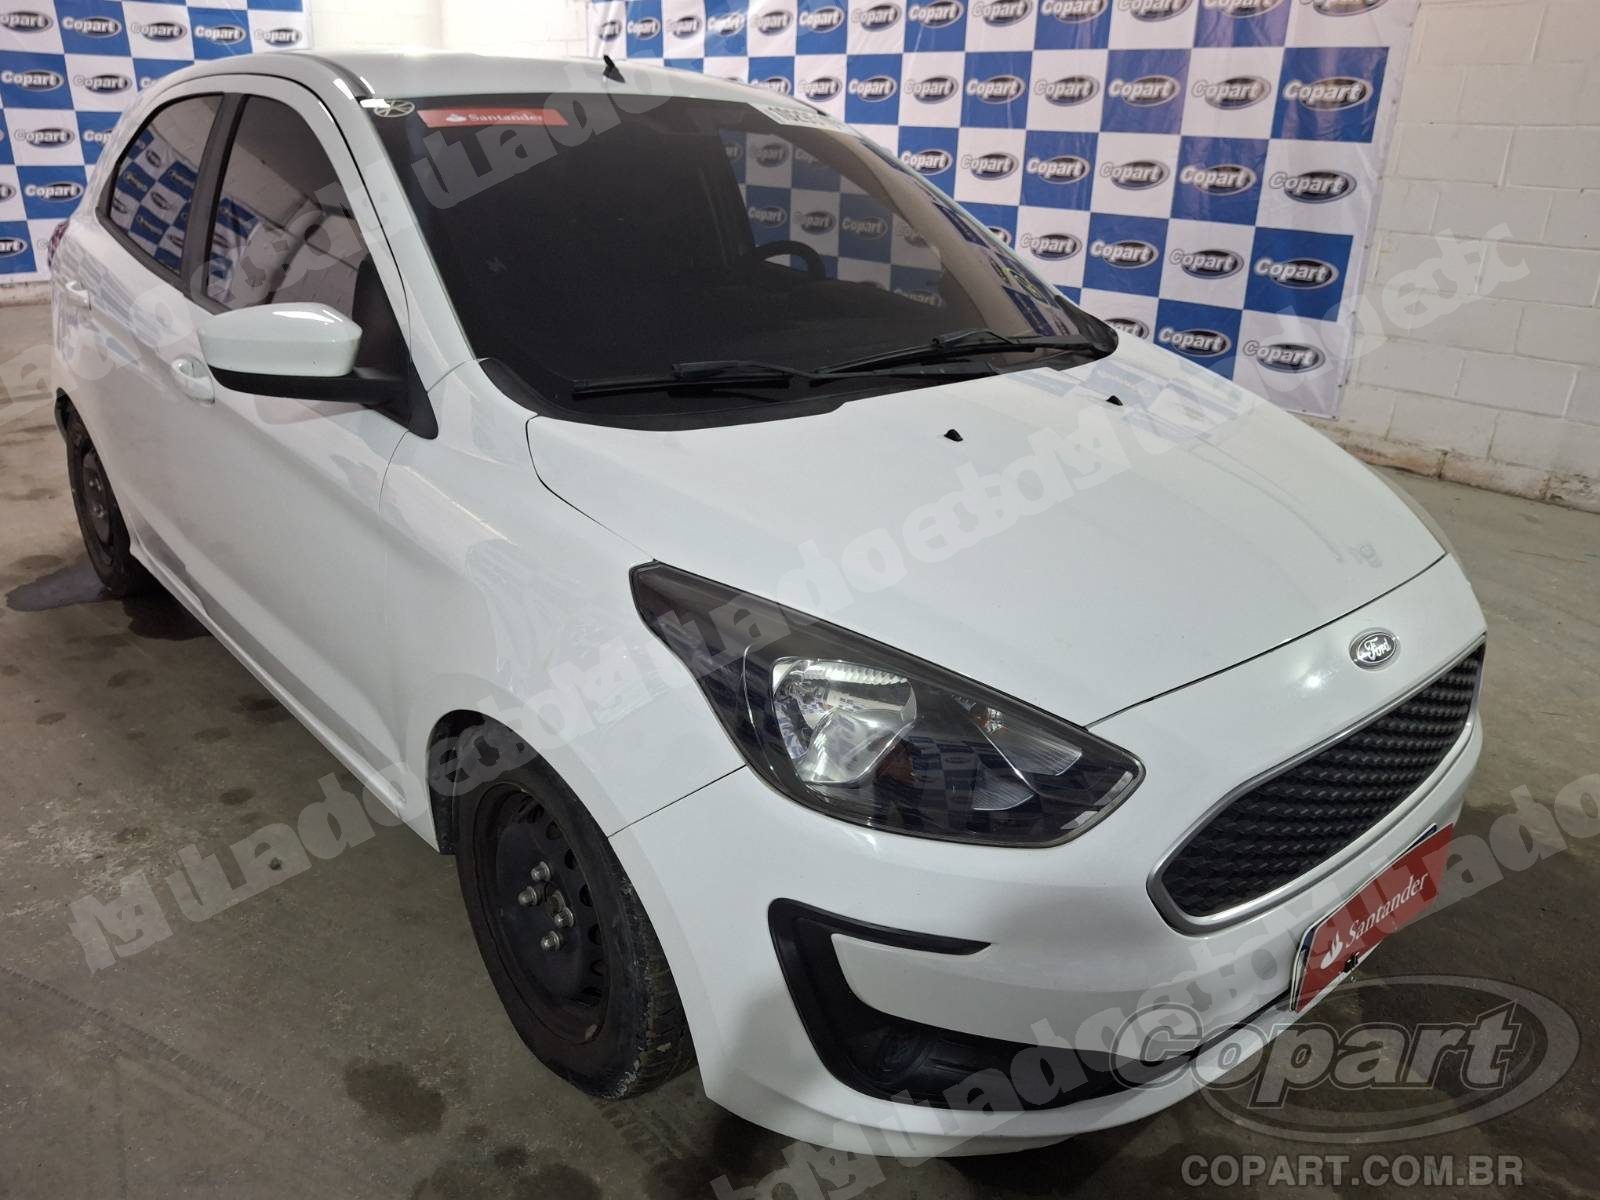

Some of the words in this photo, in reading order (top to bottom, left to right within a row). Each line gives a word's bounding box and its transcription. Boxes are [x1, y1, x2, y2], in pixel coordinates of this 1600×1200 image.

[908, 2, 955, 22] Copart
[972, 0, 1023, 20] Copart
[1041, 0, 1099, 17] Copart
[0, 13, 45, 29] opart
[62, 16, 116, 34] Copart
[800, 9, 842, 29] Copart
[853, 10, 895, 27] Copart
[131, 22, 180, 39] Copart
[195, 26, 240, 42] Copart
[255, 29, 298, 45] Copart
[628, 20, 657, 38] Copart
[1, 70, 57, 88] Copart
[73, 75, 125, 91] Copart
[849, 79, 891, 96] Copart
[904, 80, 950, 97] Copart
[966, 79, 1017, 97] Copart
[1034, 79, 1090, 99] Copart
[1109, 79, 1172, 99] Copart
[1192, 80, 1258, 101] Copart
[1283, 80, 1361, 104] Copart
[468, 111, 543, 124] Santander
[14, 129, 67, 146] Copart
[83, 130, 112, 145] Cop
[902, 149, 945, 168] Copart
[962, 155, 1011, 173] Copart
[1027, 157, 1082, 179] Copart
[1100, 162, 1159, 181] Copart
[1180, 165, 1244, 187] Copart
[25, 184, 78, 199] Copart
[1269, 172, 1344, 196] Copart
[842, 217, 882, 235] Copart
[1020, 232, 1074, 255] Copart
[1091, 239, 1151, 264] Copart
[1169, 247, 1235, 272] Copart
[1254, 256, 1328, 285] Copart
[1159, 327, 1224, 352] Copart
[1243, 340, 1316, 368] Copart
[1360, 637, 1391, 661] Ford
[1346, 869, 1429, 948] Santander
